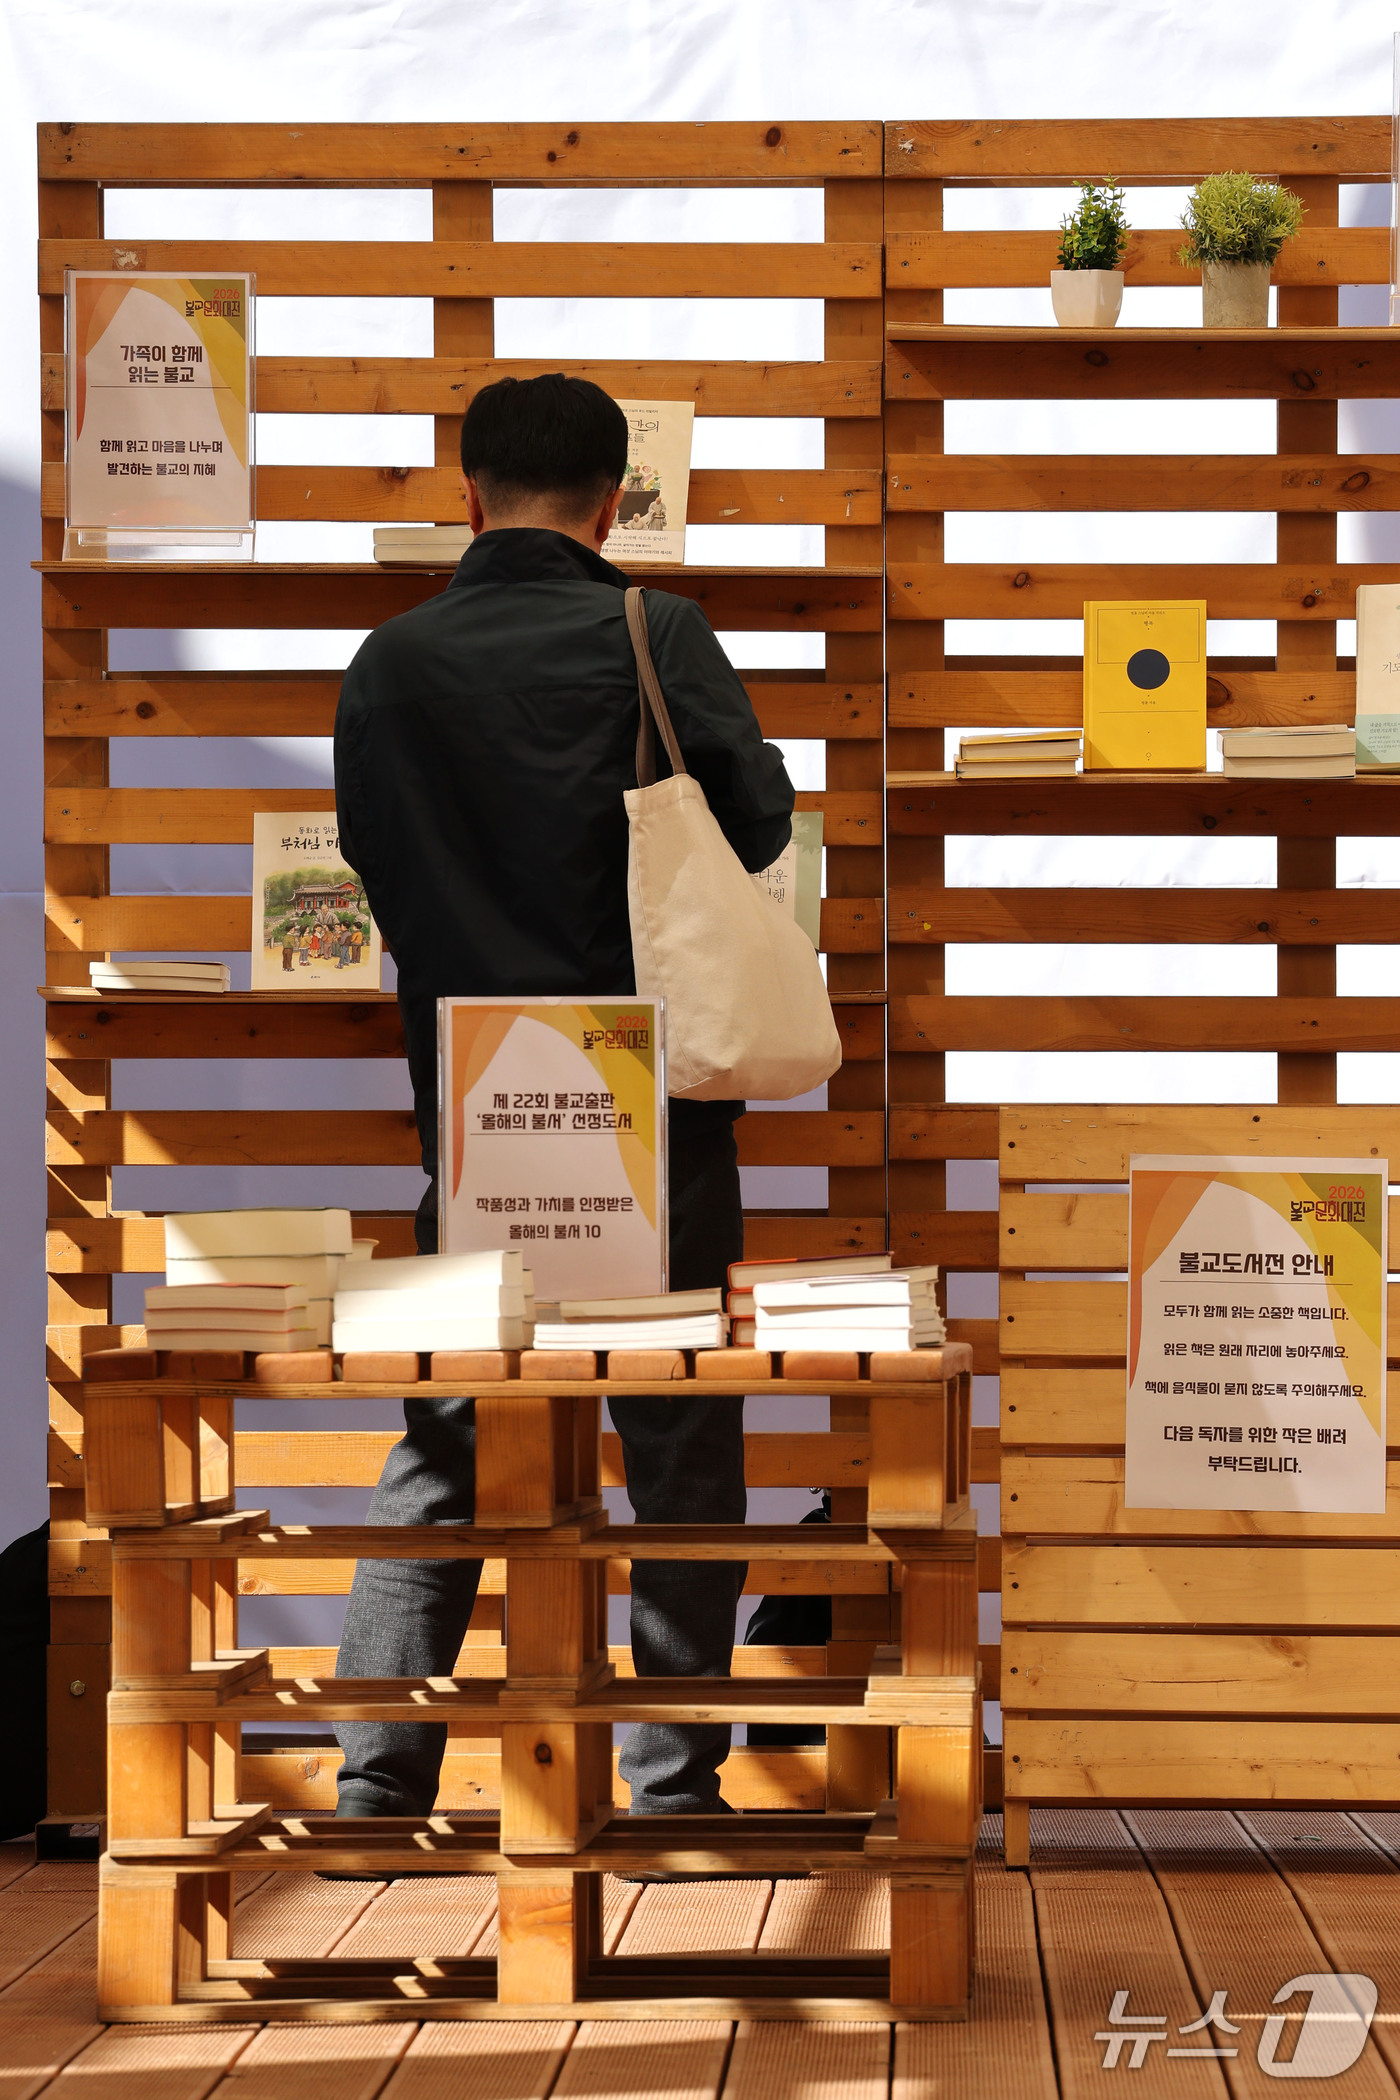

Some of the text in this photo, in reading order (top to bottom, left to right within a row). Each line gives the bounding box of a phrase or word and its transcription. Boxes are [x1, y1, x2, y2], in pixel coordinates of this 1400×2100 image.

[213, 289, 240, 299] 2026
[185, 300, 241, 318] 불교문화대전
[120, 345, 203, 362] 가족이 함께
[128, 366, 195, 384] 읽는 불교
[99, 439, 223, 454] 함께 읽고 마음을 나누며
[107, 462, 216, 476] 발견하는 불교의 지혜
[298, 826, 337, 835] 동화로 읽는
[280, 836, 321, 851] 부처님
[751, 868, 788, 884] 다운
[768, 887, 785, 903] 행
[616, 1016, 648, 1028] 2026
[584, 1029, 649, 1050] 불교문화대전
[493, 1093, 616, 1109] 제 22회 불교출판
[571, 1113, 632, 1130] 선정도서
[1328, 1186, 1365, 1199] 2026
[476, 1197, 633, 1212] 작품성과 가치를 인정받은
[1290, 1200, 1365, 1222] 불교문화대전
[509, 1224, 601, 1239] 올해의 불서 10
[1179, 1252, 1334, 1277] 불교도서전 안내
[1164, 1305, 1349, 1321] 모두가 함께 읽는 소중한 책입니다.
[1164, 1343, 1349, 1359] 읽은 책은 원래 자리에 놓아주세요.
[1144, 1380, 1367, 1399] 책에 음식물이 묻지 않도록 주의해주세요.
[1164, 1426, 1347, 1445] 다음 독자를 위한 작은 배려
[1208, 1456, 1302, 1474] 부탁드립니다.
